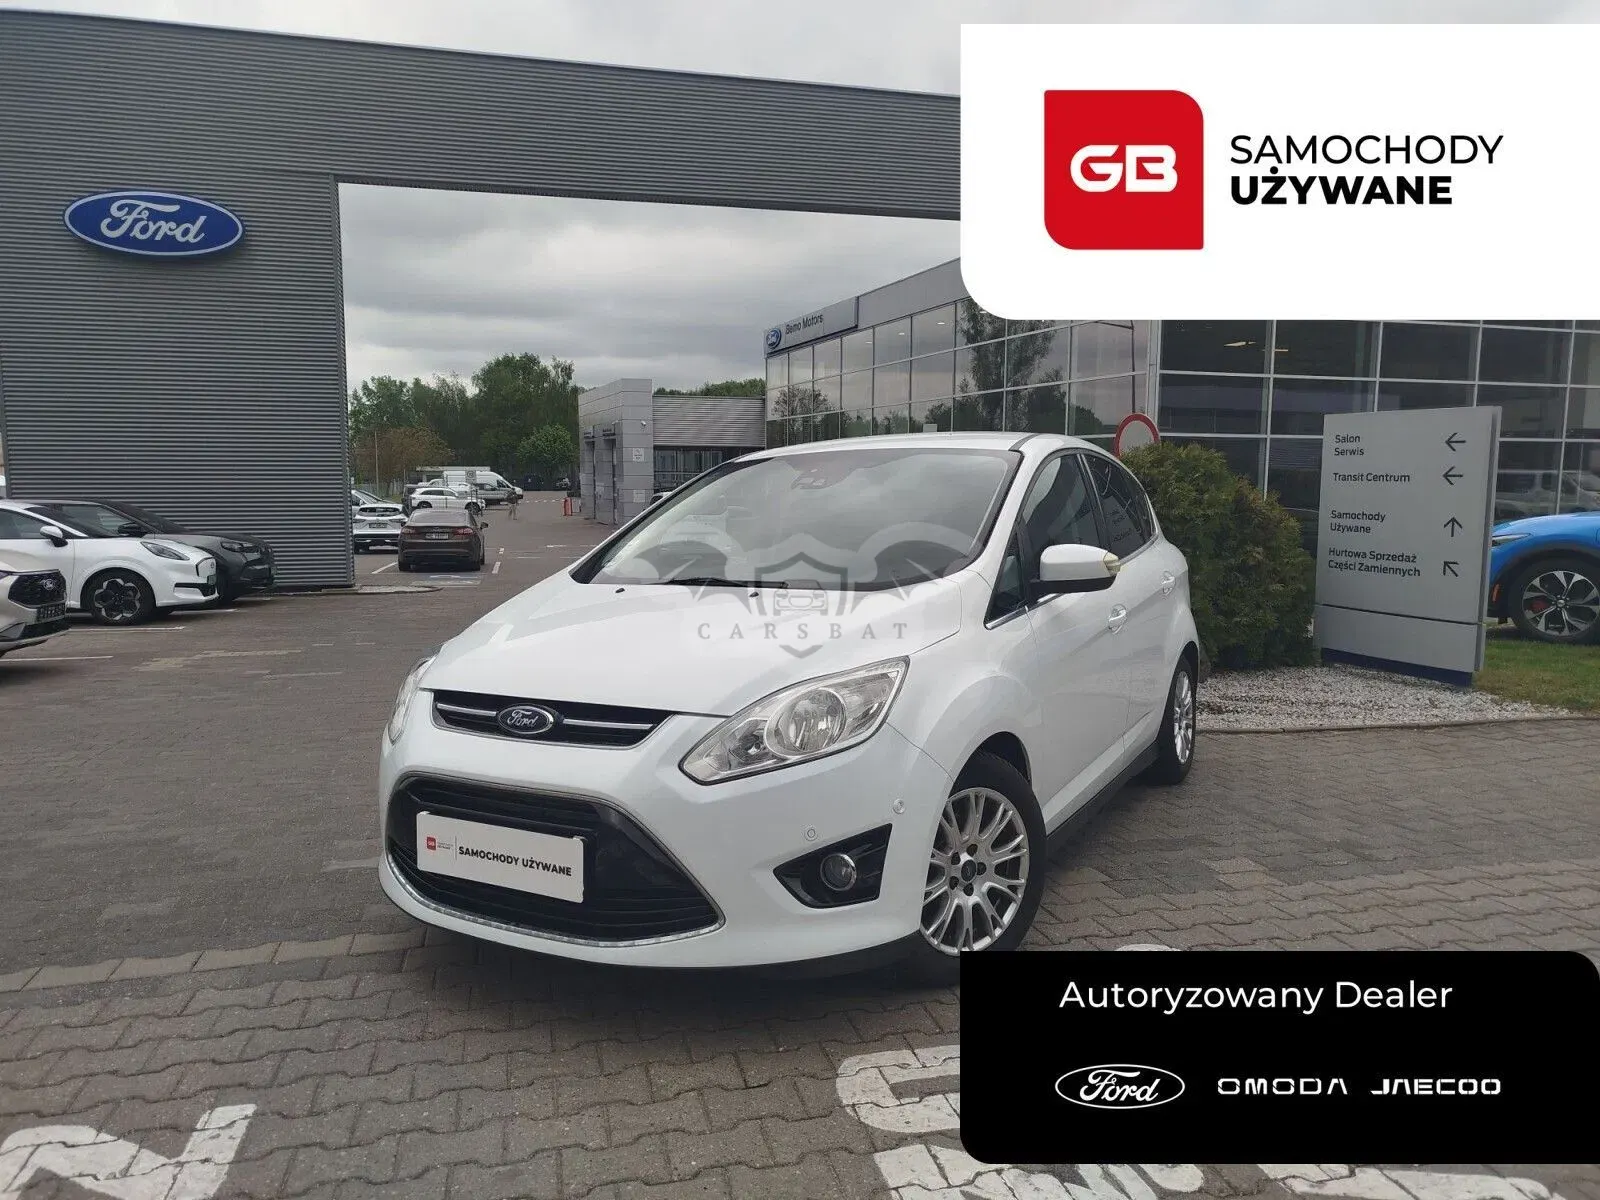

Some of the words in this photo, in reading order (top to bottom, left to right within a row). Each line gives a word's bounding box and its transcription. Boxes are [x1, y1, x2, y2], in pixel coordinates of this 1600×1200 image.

[100, 199, 207, 243] Ford
[802, 314, 824, 328] Motors
[1335, 434, 1361, 443] Salon
[1334, 447, 1364, 456] Serwis
[1333, 472, 1364, 482] Transit
[1366, 472, 1410, 482] Centrum
[1331, 510, 1386, 523] Samochody
[1330, 522, 1371, 533] Używane
[1328, 547, 1367, 559] Hurtowa
[1369, 550, 1417, 563] Sprzedaż
[1328, 560, 1356, 571] Części
[1358, 562, 1421, 577] Zamiennych
[506, 710, 540, 728] Ford
[458, 846, 519, 866] SAMOCHODY
[521, 857, 572, 876] UŻYWANE
